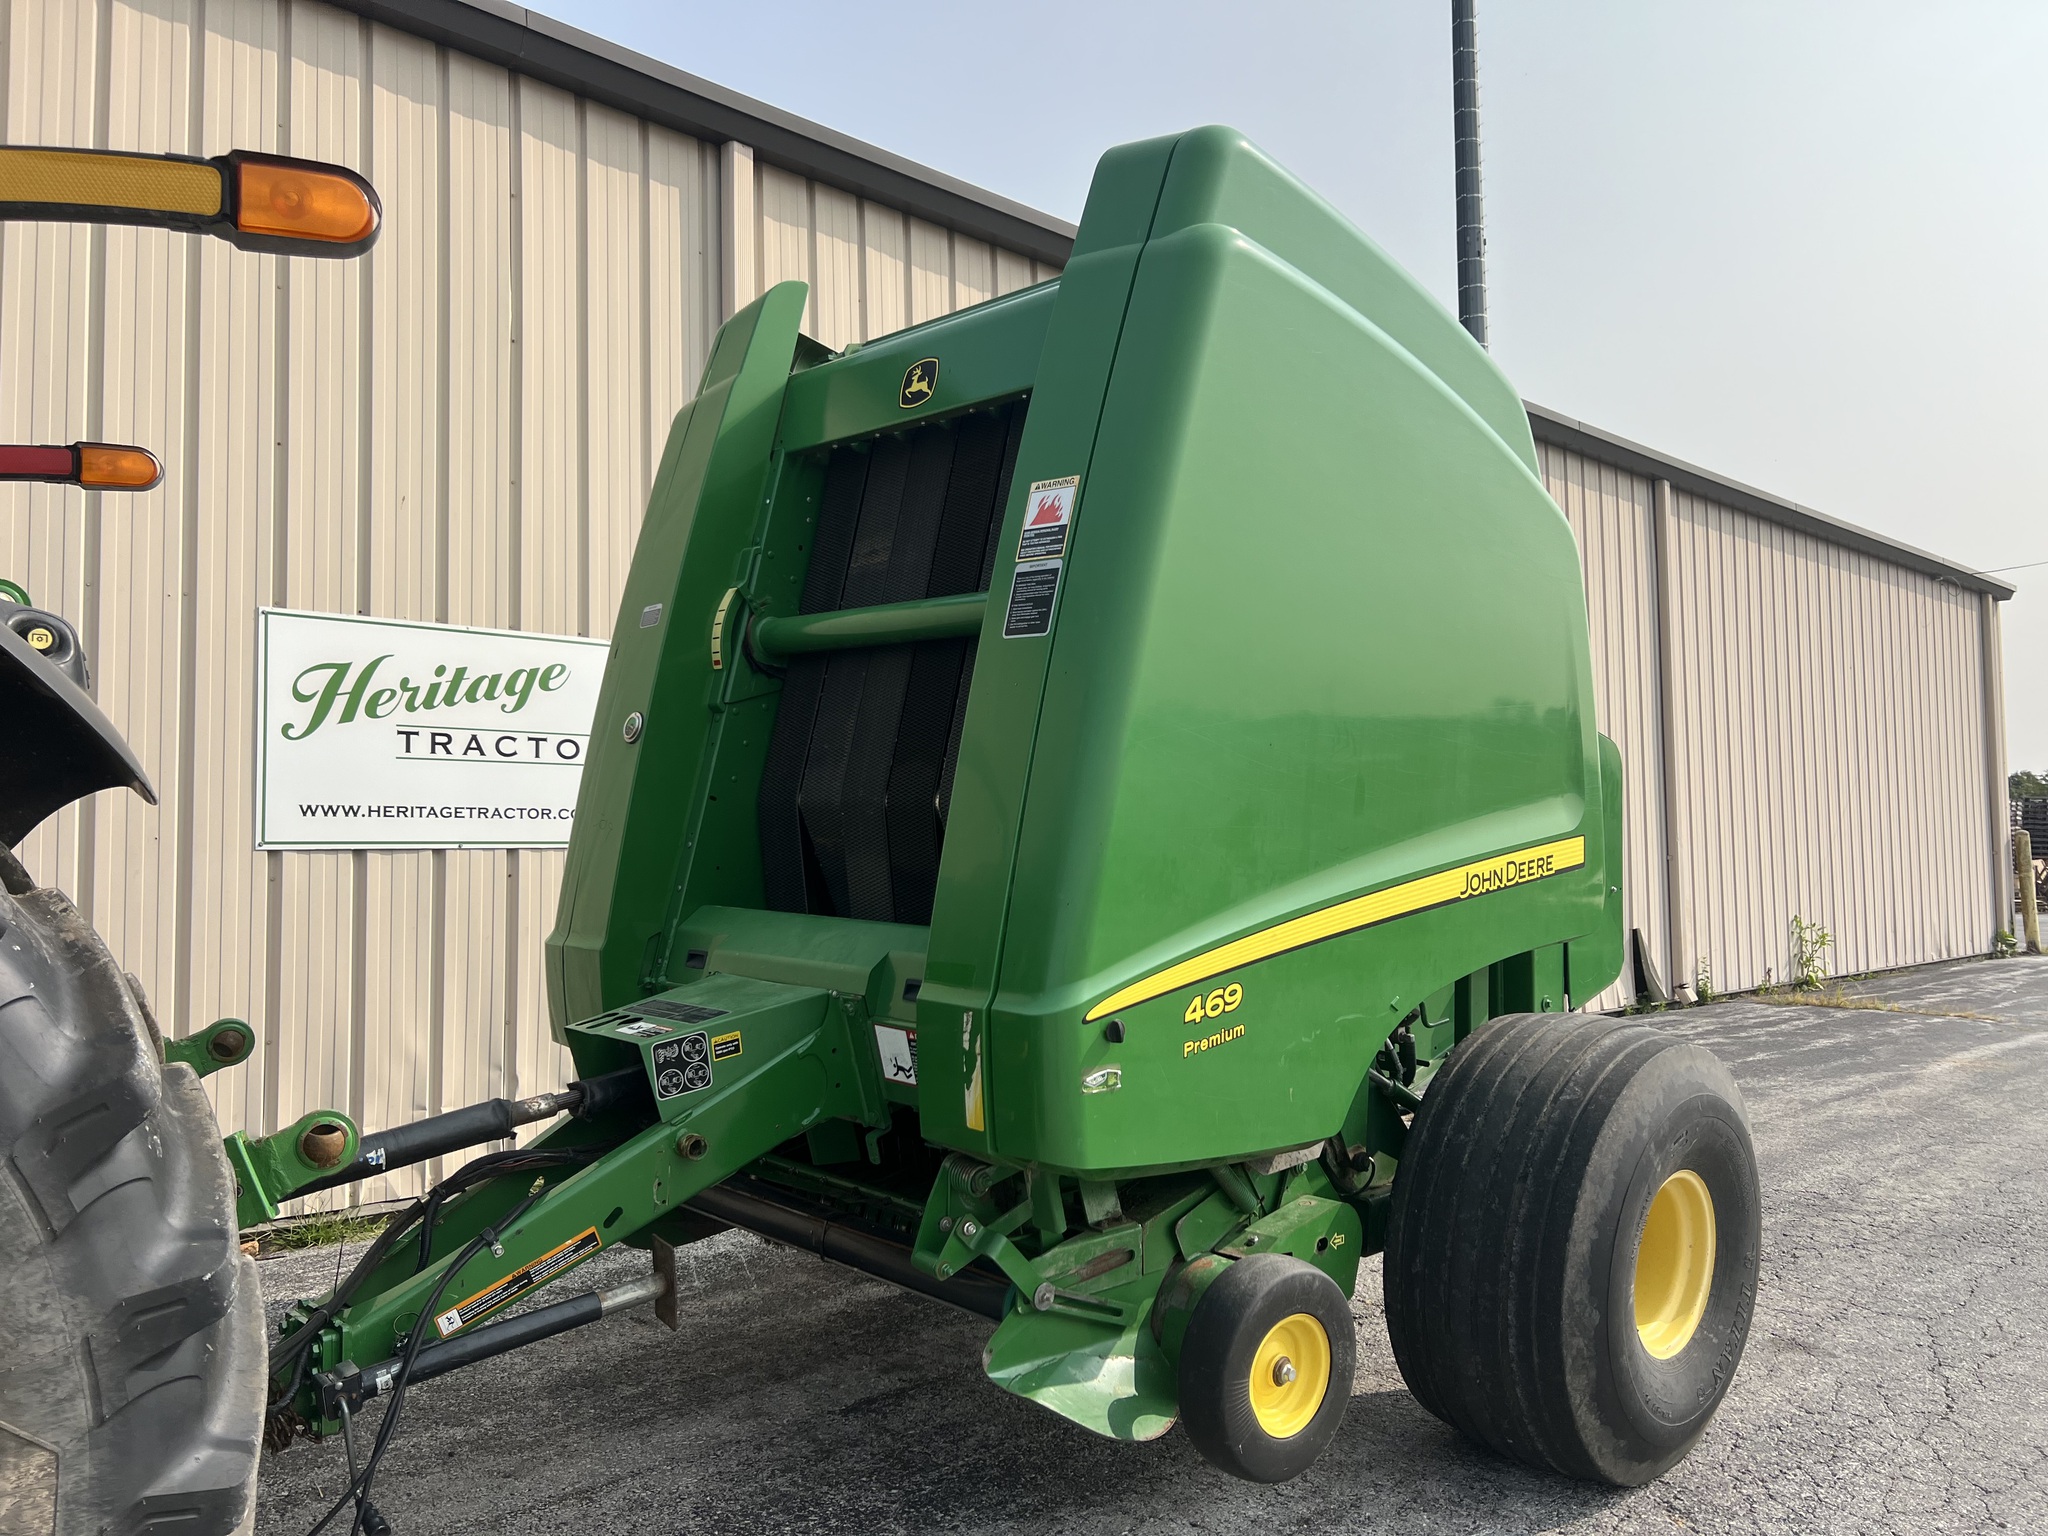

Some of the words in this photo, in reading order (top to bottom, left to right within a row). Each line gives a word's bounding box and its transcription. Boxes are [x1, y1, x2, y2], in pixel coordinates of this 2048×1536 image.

[1041, 478, 1075, 489] WARNING
[281, 654, 571, 741] Heritage
[397, 730, 580, 760] TRACTO
[1460, 867, 1503, 895] JOHN
[1506, 854, 1554, 883] DEERE
[1183, 982, 1243, 1024] 469
[1183, 1024, 1245, 1058] Premium
[515, 1257, 543, 1275] WARNING
